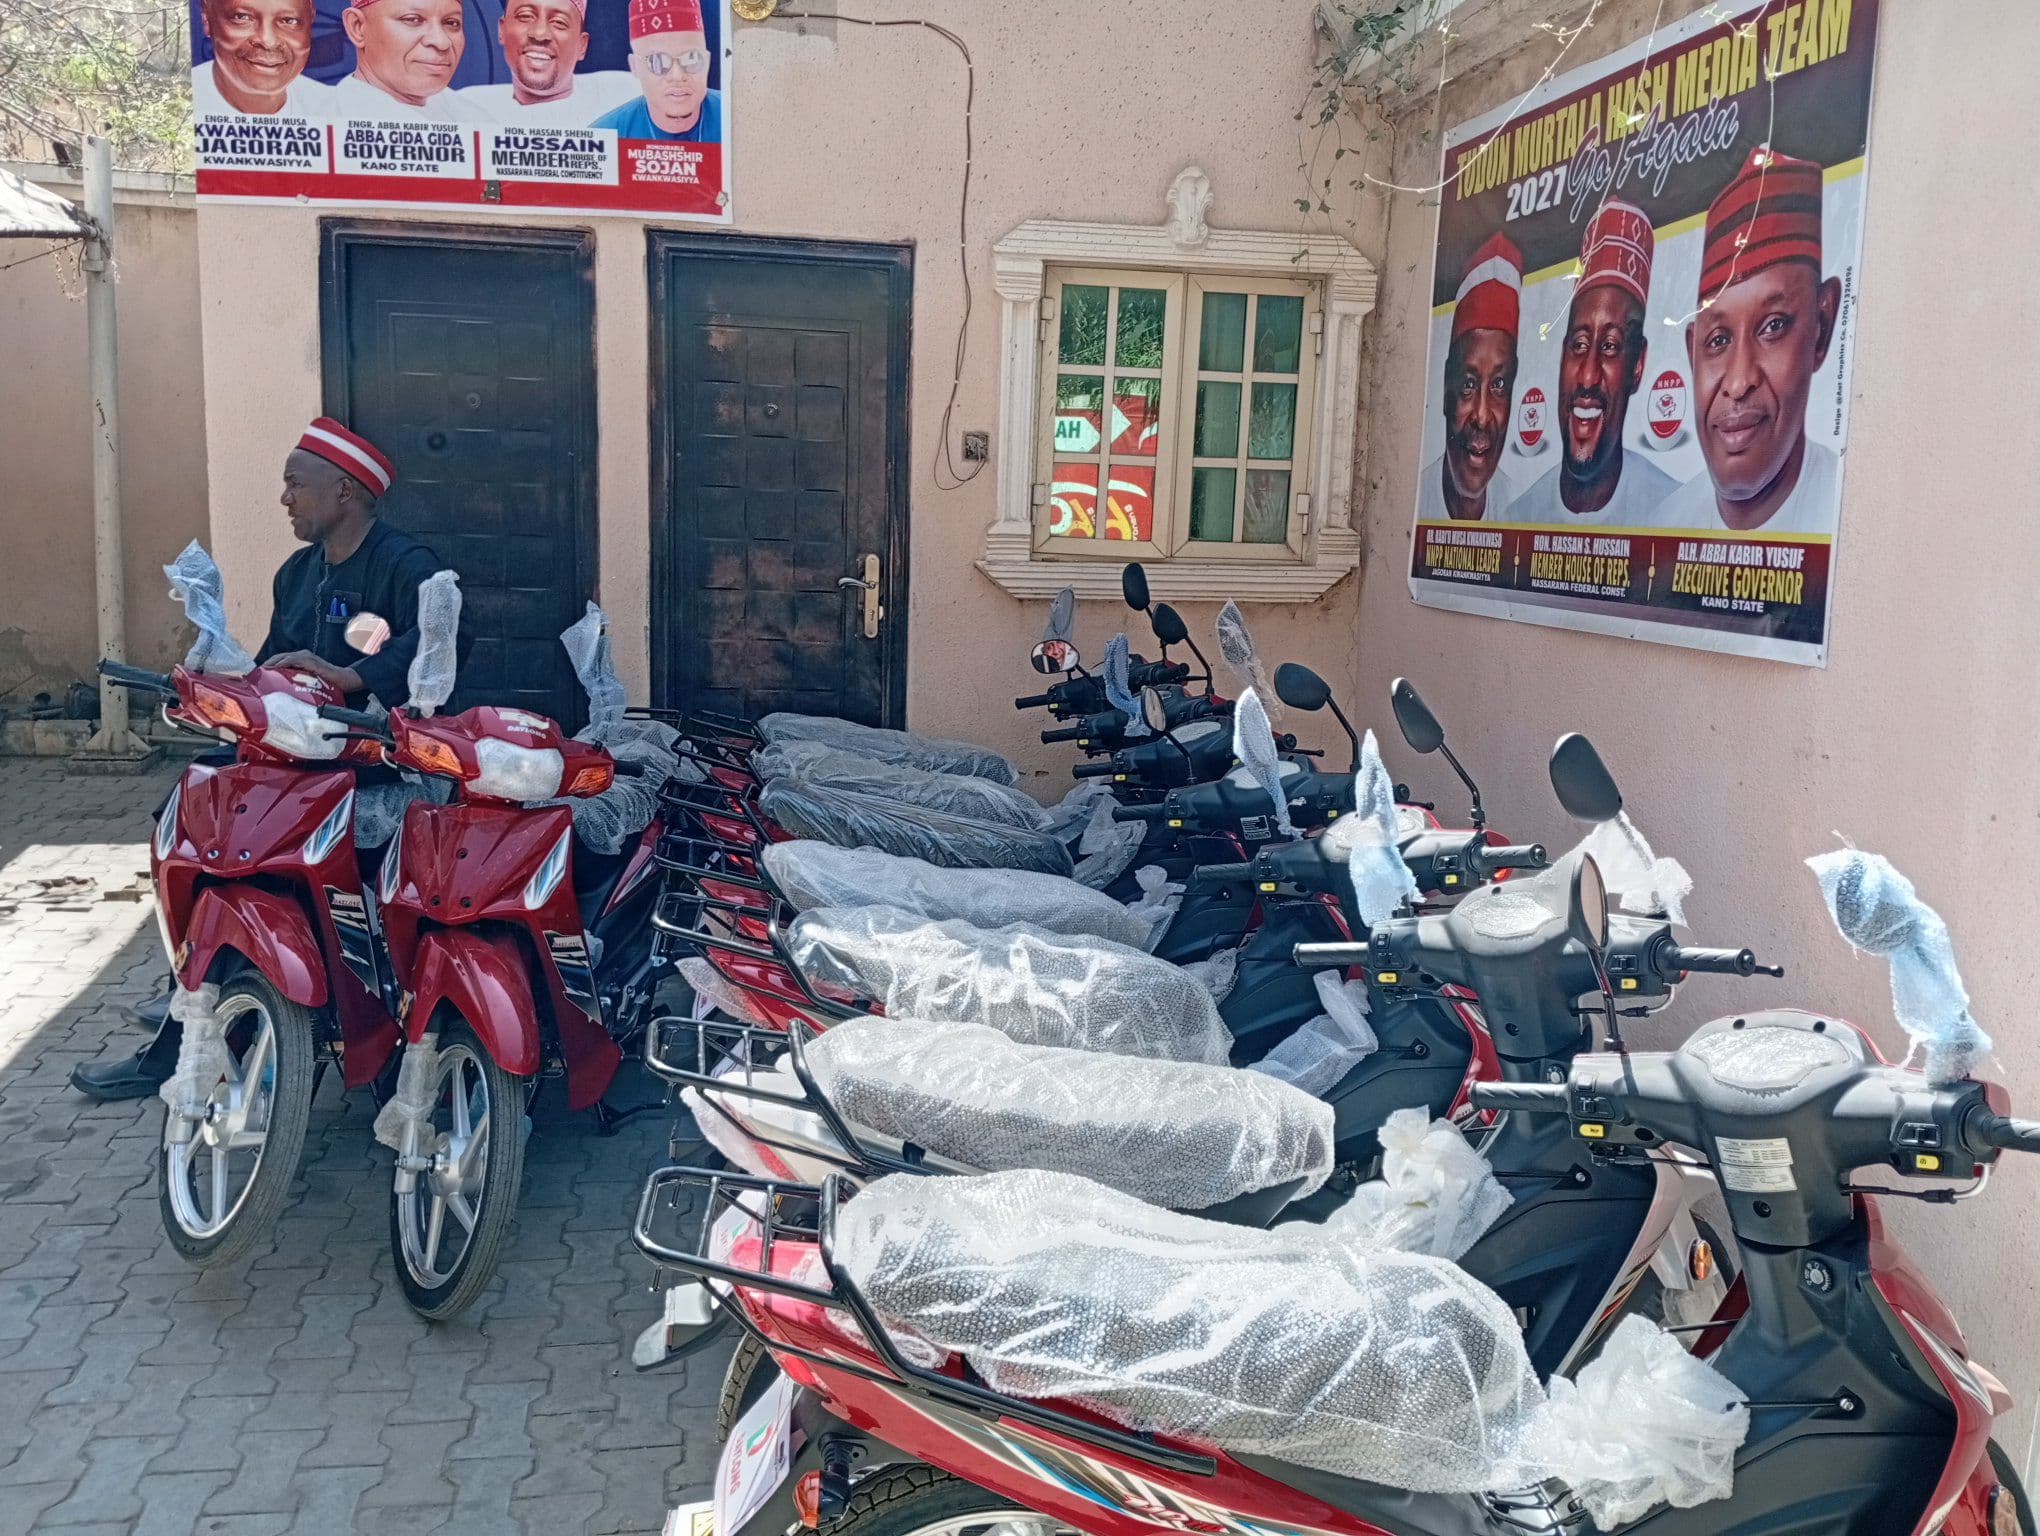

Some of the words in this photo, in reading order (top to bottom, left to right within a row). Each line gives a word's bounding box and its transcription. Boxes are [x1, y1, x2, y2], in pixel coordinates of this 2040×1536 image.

[1457, 132, 1511, 200] TUDUN
[1513, 92, 1601, 180] MURTALA
[1606, 62, 1669, 143] HASH
[1673, 23, 1758, 118] MEDIA
[1767, 0, 1852, 80] TEAM
[205, 115, 232, 124] ENGR.
[235, 116, 250, 124] DR.
[253, 117, 278, 125] RABIU
[282, 118, 306, 126] MUSA
[348, 120, 374, 128] ENGR.
[378, 122, 400, 130] ABBA
[431, 124, 458, 132] YUSUF
[194, 124, 320, 141] KWANKWASO
[345, 130, 385, 143] ABBA
[389, 131, 424, 145] GIDA
[428, 133, 462, 146] GIDA
[504, 127, 526, 135] HON.
[529, 128, 562, 136] HASSAN
[564, 130, 593, 138] SHEHU
[195, 138, 322, 157] JAGORAN
[494, 136, 604, 152] HUSSAIN
[344, 143, 466, 162] GOVERNOR
[492, 151, 569, 168] MEMBER
[570, 153, 594, 161] HOUSE
[598, 154, 607, 162] OF
[628, 149, 703, 162] MUBASHSHIR
[1506, 165, 1568, 222] 2027
[1568, 124, 1611, 223] Go
[1617, 97, 1739, 197] Again
[204, 156, 312, 167] KWANKWASIYYA
[361, 162, 397, 170] KANO
[400, 163, 439, 172] STATE
[570, 160, 602, 170] REPS.
[636, 160, 696, 176] SOJAN
[496, 168, 533, 176] NASSARAWA
[534, 169, 559, 178] FEDERAL
[561, 170, 602, 179] CONSTITUENCY
[632, 174, 700, 184] KWANKWASIYYA
[1657, 378, 1680, 388] NNPP
[1534, 535, 1550, 552] HON.
[1552, 536, 1583, 554] HASSAN
[1584, 537, 1591, 554] S.
[1592, 538, 1630, 557] HUSSAIN
[1426, 544, 1444, 568] NNPP
[1444, 546, 1475, 570] NATIONAL
[1476, 548, 1500, 574] LEADER
[1678, 542, 1698, 561] ALH.
[1700, 544, 1727, 563] ABBA
[1728, 544, 1763, 566] KABIR
[1766, 546, 1804, 569] YUSUF
[1530, 552, 1563, 580] MEMBER
[1565, 555, 1592, 583] HOUSE
[1594, 556, 1604, 584] OF
[1607, 558, 1630, 587] REPS.
[1532, 579, 1569, 590] NASSARAWA
[1570, 583, 1599, 594] FEDERAL
[1601, 586, 1626, 598] CONST.
[1672, 562, 1730, 597] EXECUTIVE
[1732, 567, 1804, 604] GOVERNOR
[1702, 596, 1729, 608] KANO
[1732, 600, 1764, 612] STATE
